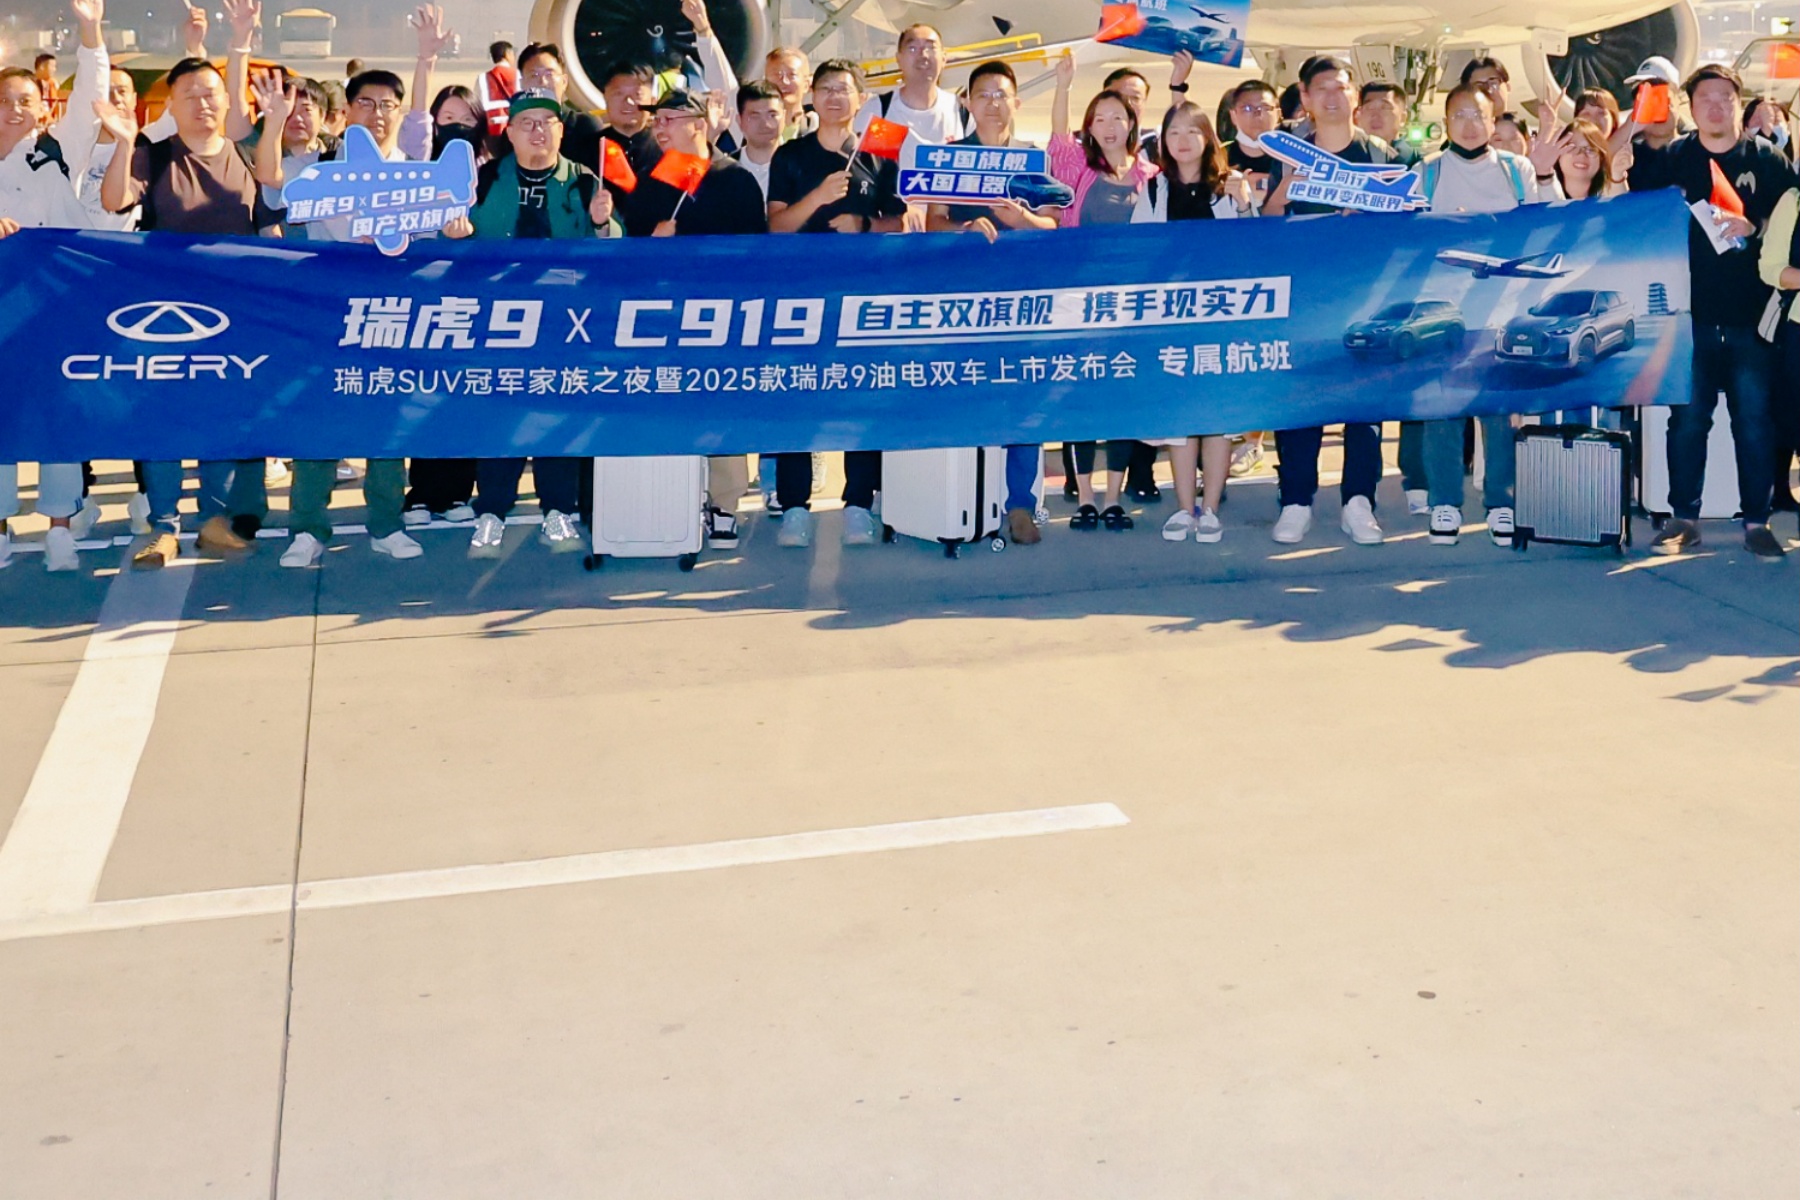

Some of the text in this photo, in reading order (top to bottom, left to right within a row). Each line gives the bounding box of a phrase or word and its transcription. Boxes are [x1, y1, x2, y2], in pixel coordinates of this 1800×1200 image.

[927, 148, 1028, 172] 中国旗舰
[905, 173, 1008, 196] 大国重器
[1289, 182, 1405, 212] 把世界变成眼界
[290, 194, 355, 220] 瑞虎9
[371, 185, 436, 209] C919
[338, 295, 544, 349] 瑞虎9
[614, 298, 826, 348] C919
[855, 294, 1055, 332] 自主双旗舰
[1082, 282, 1277, 323] 携手现实力
[62, 353, 269, 380] CHERY
[333, 340, 1293, 395] 瑞虎SUV冠军家族之夜暨2025款瑞虎9油电双车上市发布会 专属航班
